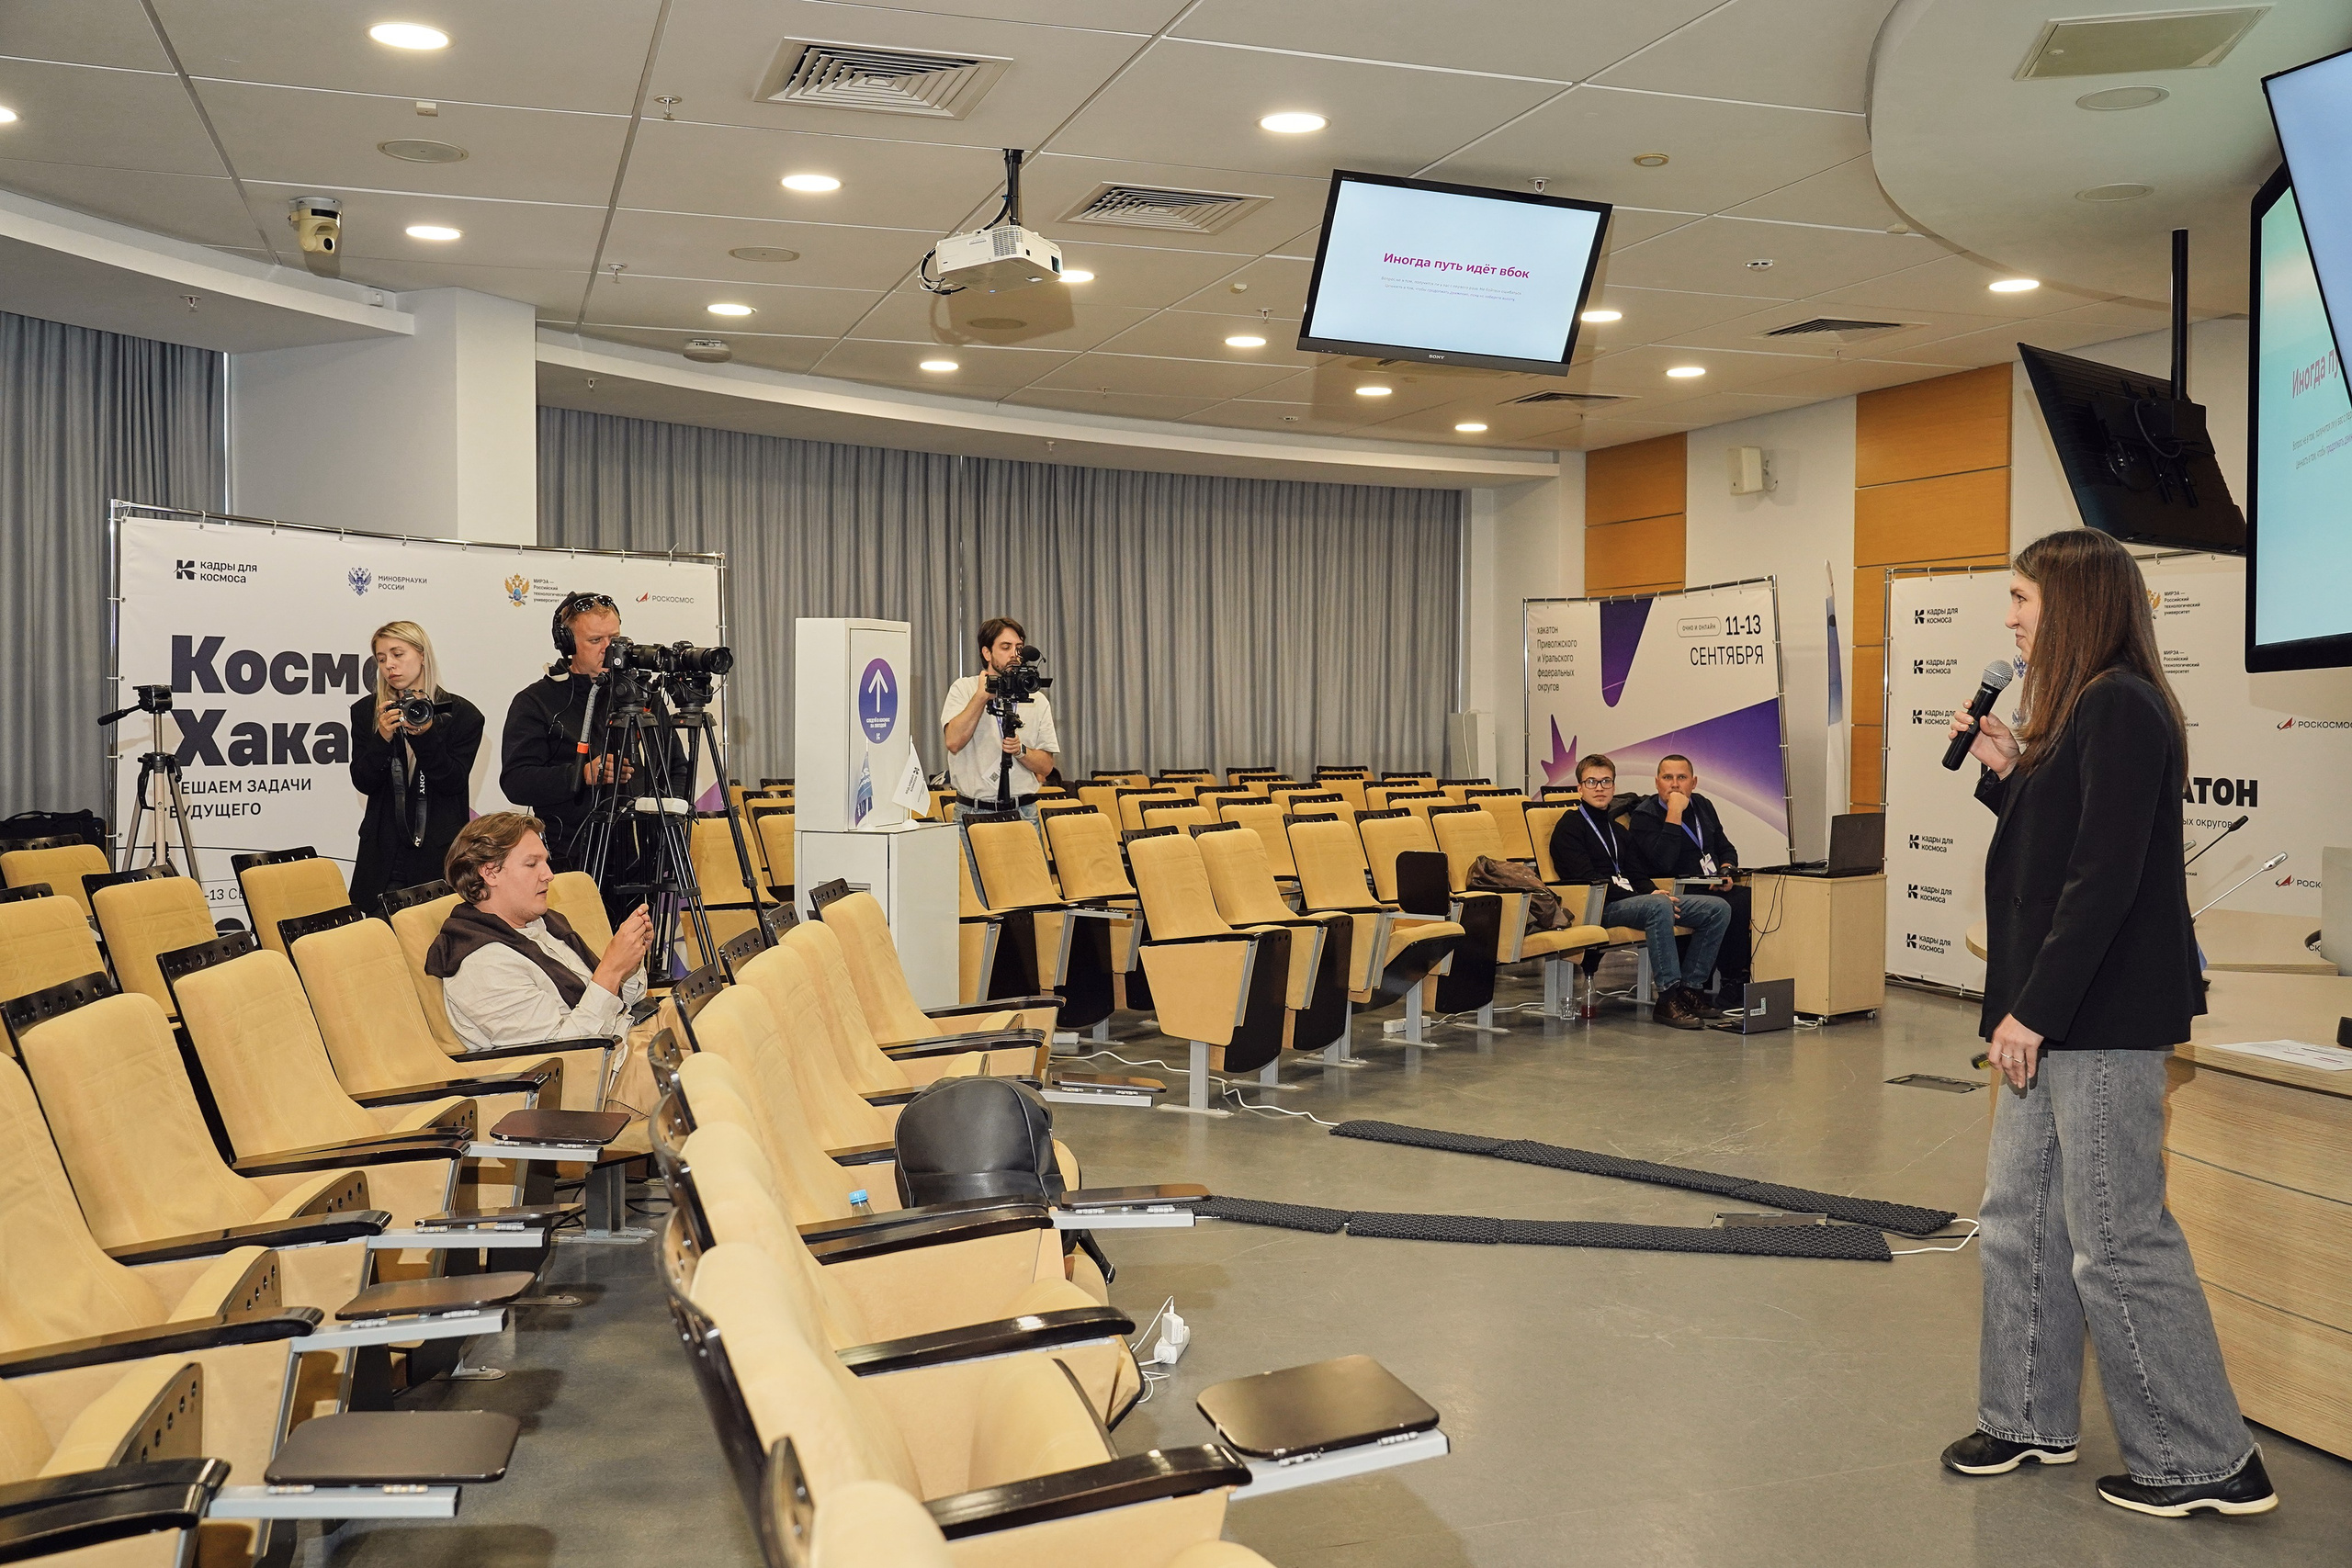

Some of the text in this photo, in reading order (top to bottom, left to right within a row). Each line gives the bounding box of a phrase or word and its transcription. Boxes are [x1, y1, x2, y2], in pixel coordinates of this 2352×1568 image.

[1384, 253, 1530, 278] Иногда путь идёт вбок
[2292, 355, 2326, 399] Иногда
[200, 561, 257, 572] кадры для
[200, 573, 246, 583] космоса
[378, 575, 427, 583] МИНОБРНАУКИ
[652, 595, 694, 604] РОСКОСМОС
[1725, 614, 1761, 635] 11-13
[1537, 639, 1577, 650] Приволжского
[1542, 654, 1573, 664] Уральского
[1690, 645, 1764, 666] СЕНТЯБРЯ
[1537, 668, 1574, 679] федеральных
[1537, 684, 1559, 693] округов
[1925, 709, 1944, 717] кадры
[170, 779, 311, 795] ЕШАЕМ ЗАДАЧИ
[2196, 819, 2232, 829] округов
[1922, 835, 1941, 844] кадры
[1921, 844, 1947, 853] космоса
[2297, 880, 2322, 888] РОСК
[1920, 885, 1940, 894] кадры
[1920, 894, 1945, 903] космоса
[1919, 935, 1939, 944] кадры
[1919, 944, 1944, 954] космоса
